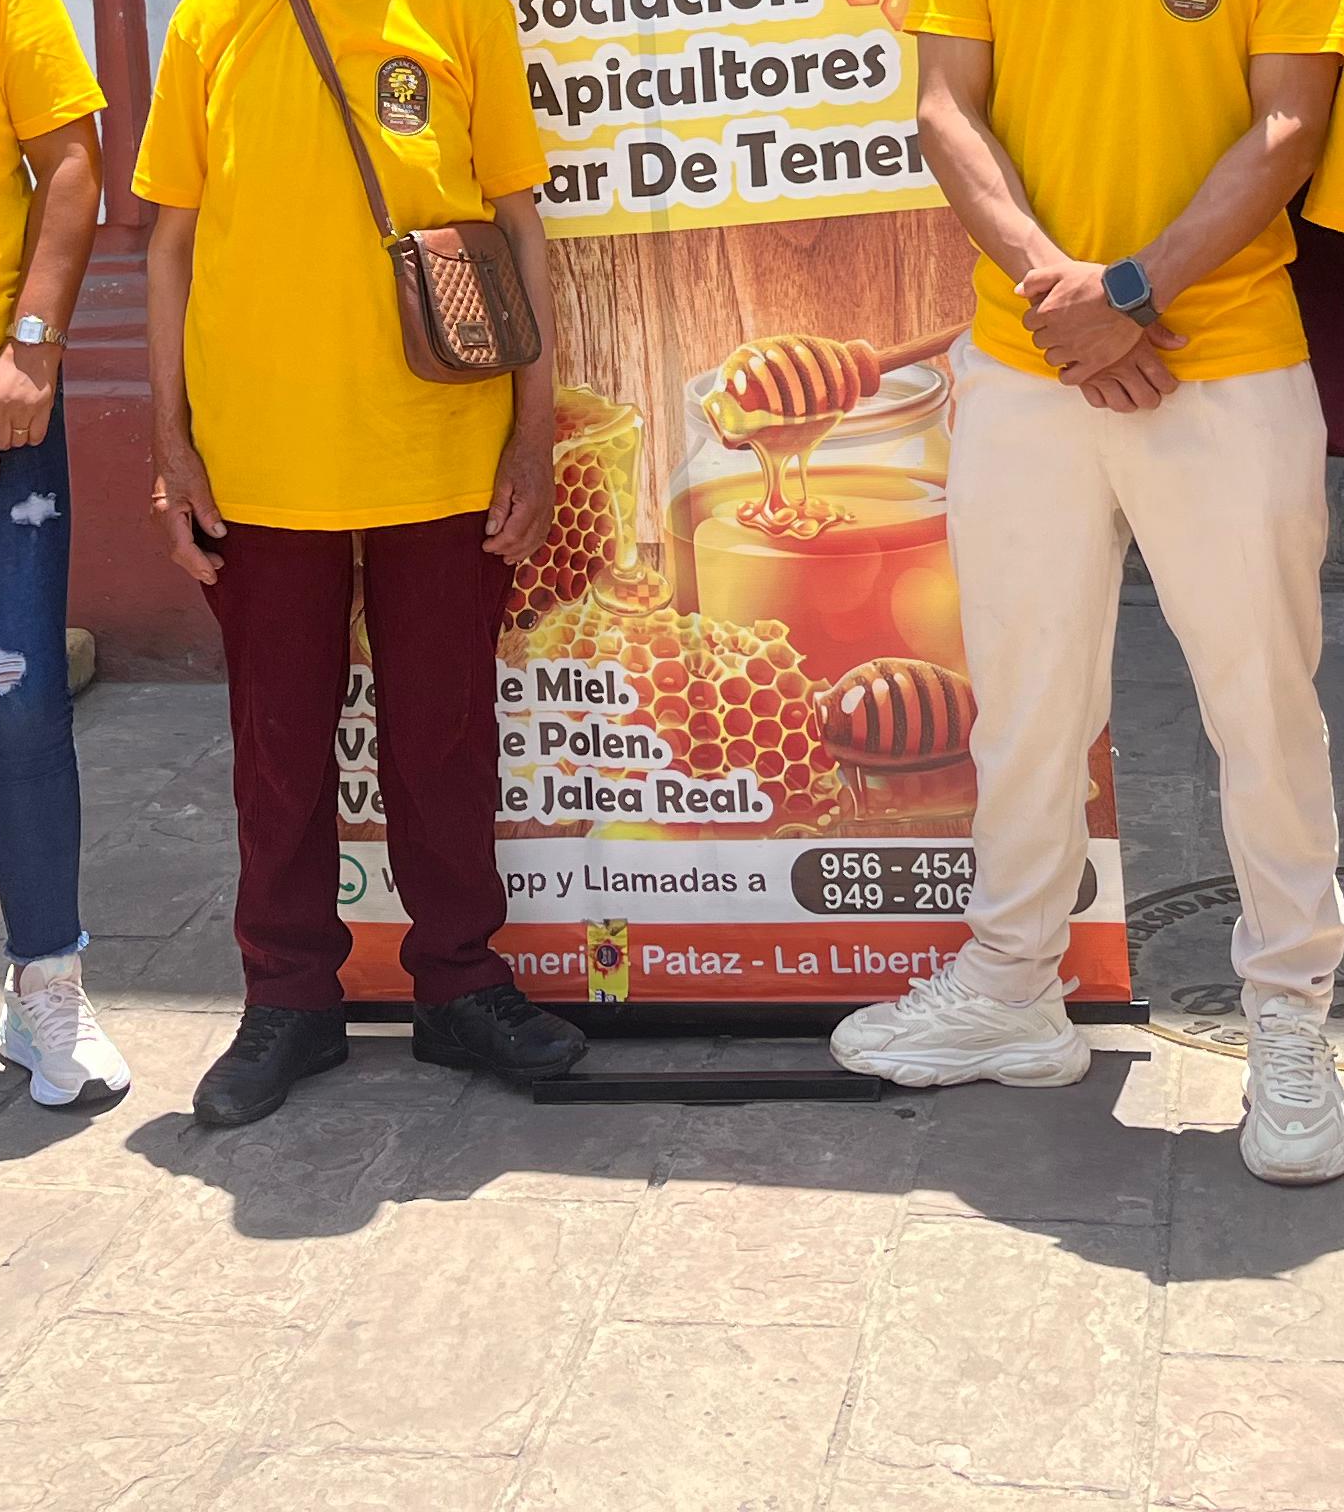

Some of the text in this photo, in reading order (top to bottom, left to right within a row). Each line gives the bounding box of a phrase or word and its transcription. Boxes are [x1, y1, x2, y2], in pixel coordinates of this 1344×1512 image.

[526, 44, 887, 127] Apicultores
[628, 141, 718, 197] De
[736, 129, 923, 188] Tener
[536, 667, 630, 705] Miel.
[539, 721, 664, 760] Polen.
[541, 776, 643, 815] Jalea
[656, 779, 764, 814] Real.
[556, 869, 573, 897] y
[584, 865, 737, 892] Llamadas
[748, 874, 767, 892] a
[820, 853, 882, 879] 956
[910, 853, 973, 879] 454
[822, 883, 884, 909] 949
[502, 945, 586, 975] eneri
[643, 945, 742, 975] Pataz
[775, 945, 819, 975] La
[830, 944, 957, 975] Liberta
